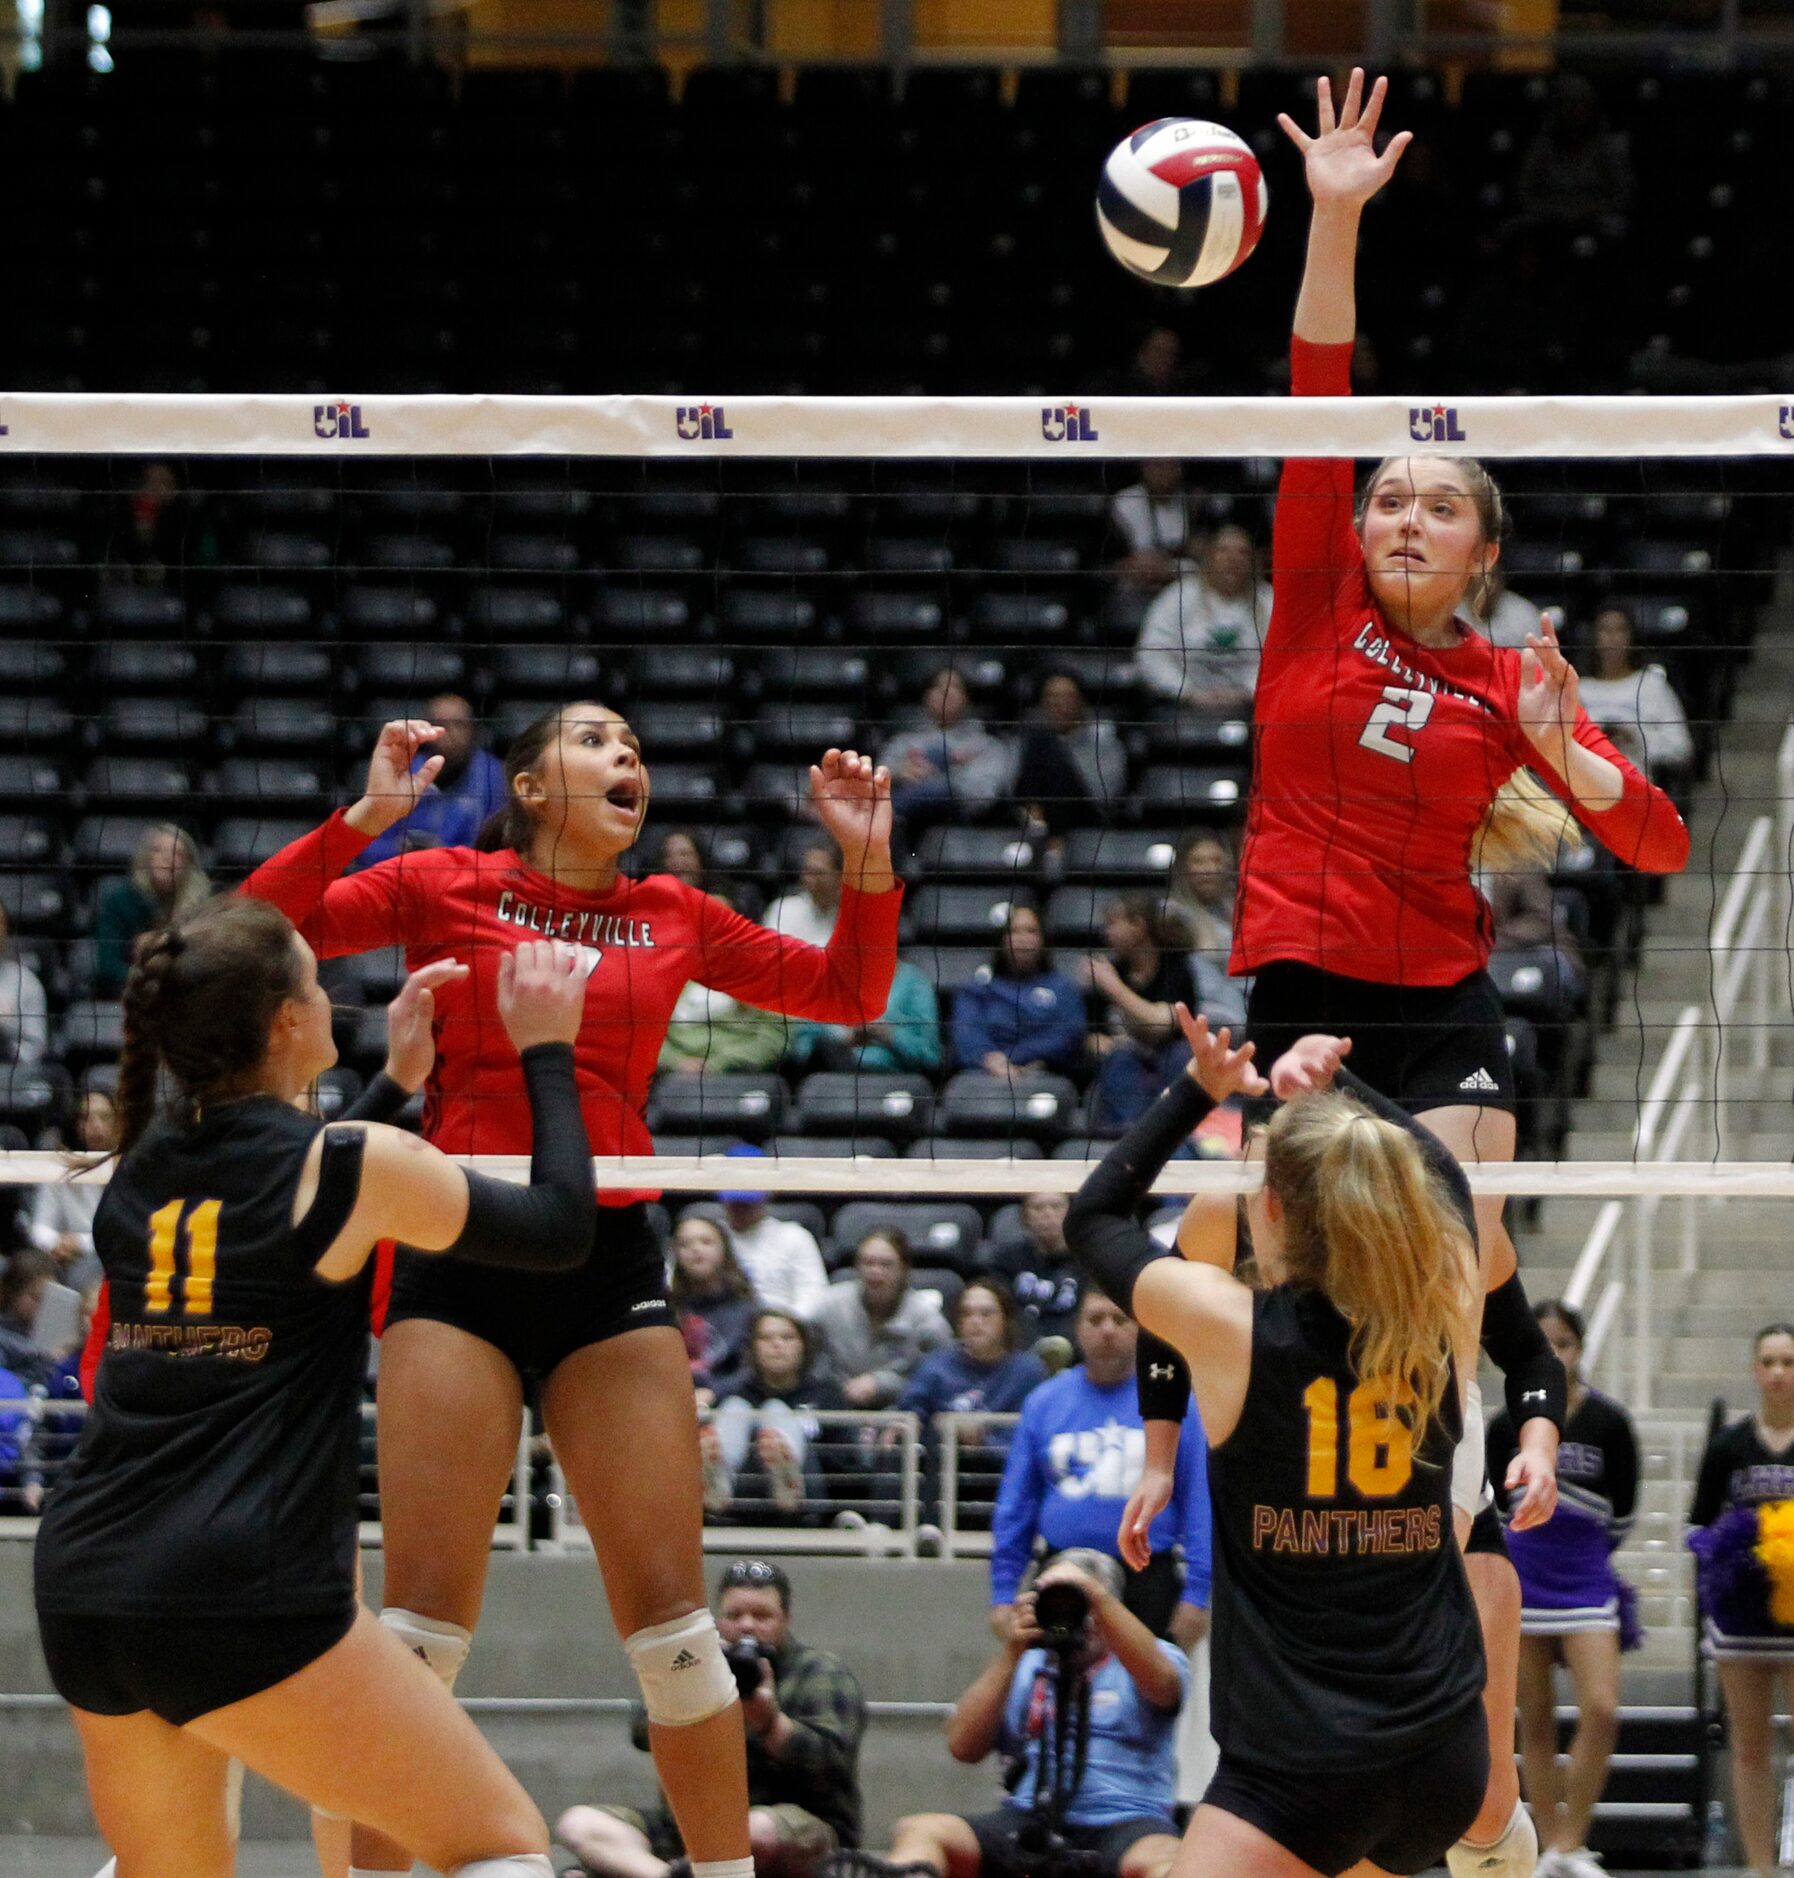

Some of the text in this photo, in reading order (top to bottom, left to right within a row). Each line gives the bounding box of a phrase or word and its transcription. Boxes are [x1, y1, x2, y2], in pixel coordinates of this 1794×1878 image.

[1358, 685, 1436, 764] 2
[497, 889, 656, 948] COLLEYVILLE
[1459, 1080, 1499, 1090] addas
[145, 1199, 223, 1314] 11
[1303, 1375, 1414, 1496] 16
[1253, 1503, 1442, 1554] PANTHERS
